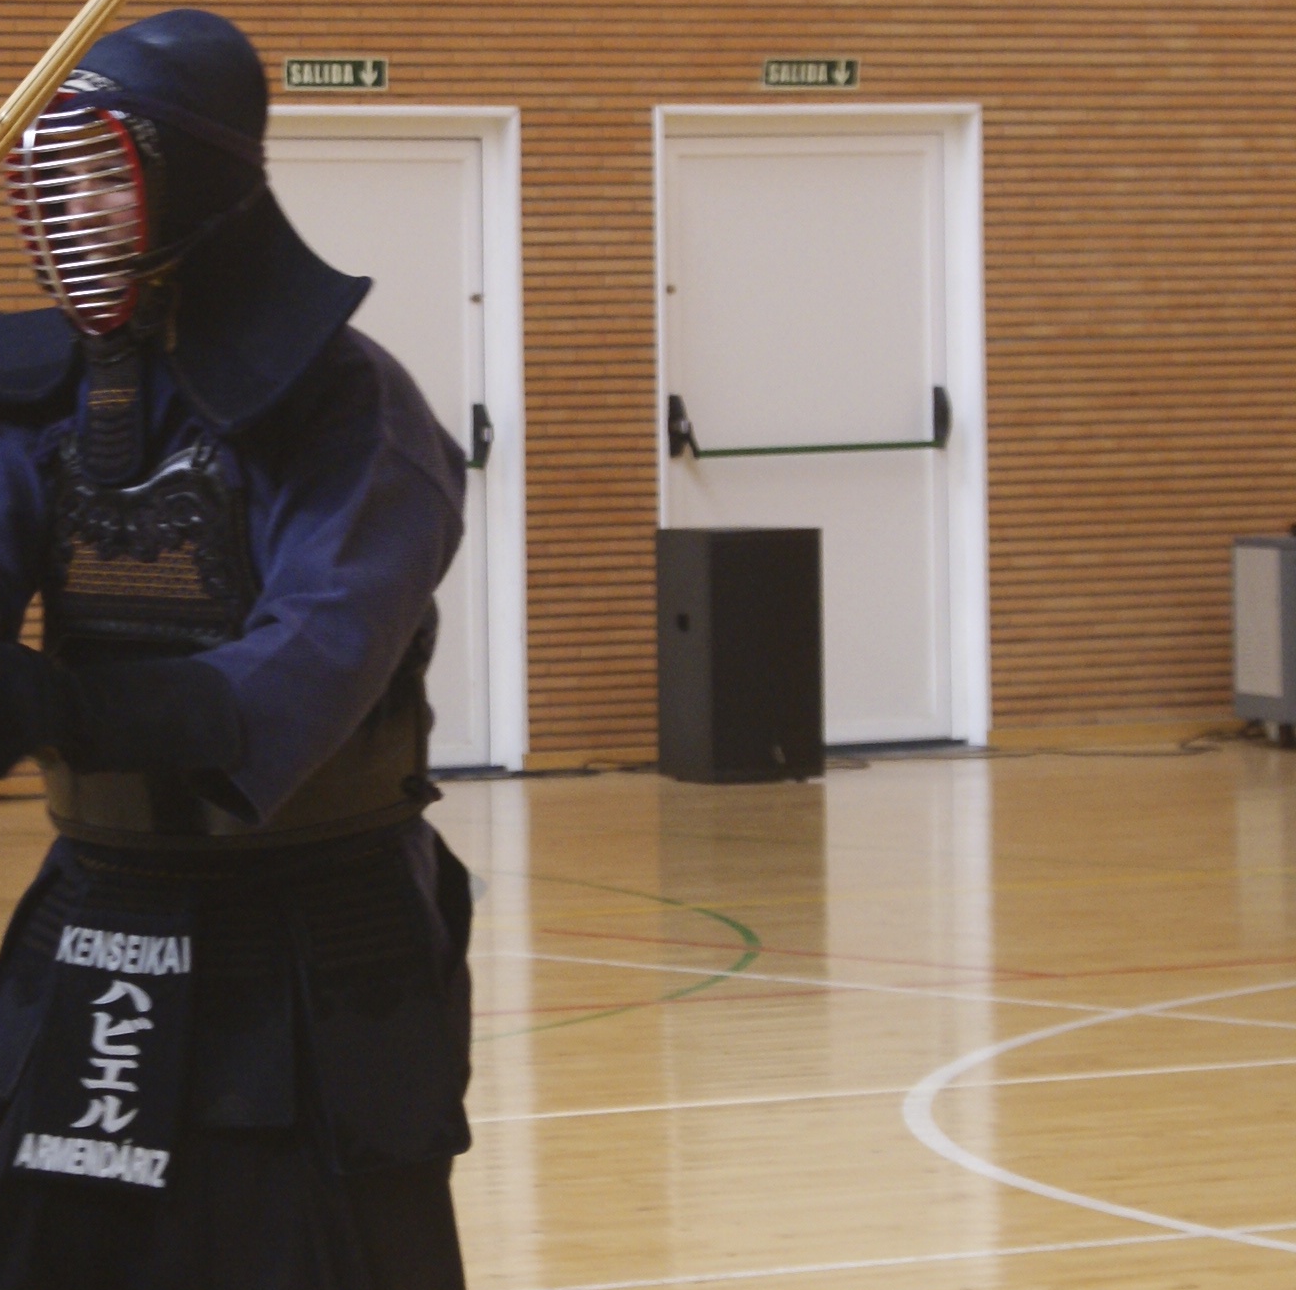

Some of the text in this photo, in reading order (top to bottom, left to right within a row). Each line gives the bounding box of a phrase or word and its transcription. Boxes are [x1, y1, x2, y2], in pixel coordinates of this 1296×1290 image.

[290, 63, 355, 85] SALIDA
[768, 63, 829, 84] SALIDA
[55, 924, 192, 976] KENSEIKAI
